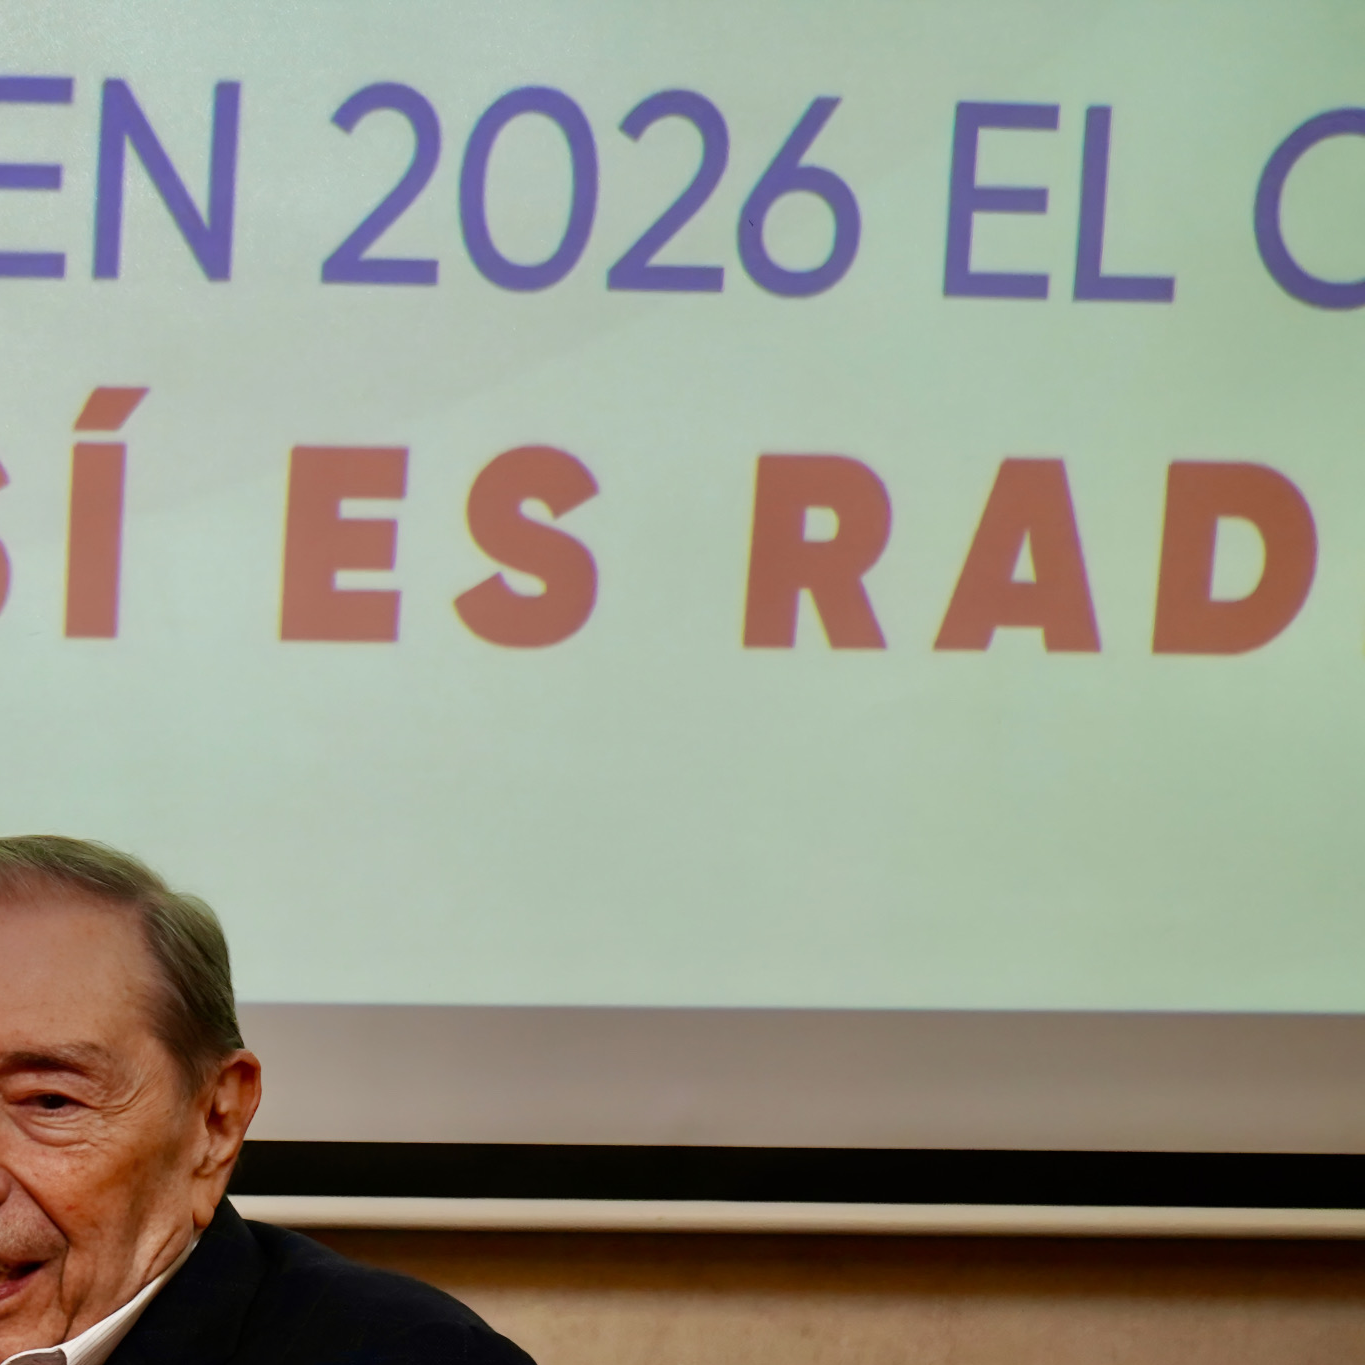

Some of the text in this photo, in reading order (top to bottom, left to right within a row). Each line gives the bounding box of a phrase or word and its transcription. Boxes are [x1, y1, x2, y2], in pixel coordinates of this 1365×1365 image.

[321, 81, 863, 297] 2026
[943, 101, 1176, 303] EL
[279, 444, 601, 650] ES
